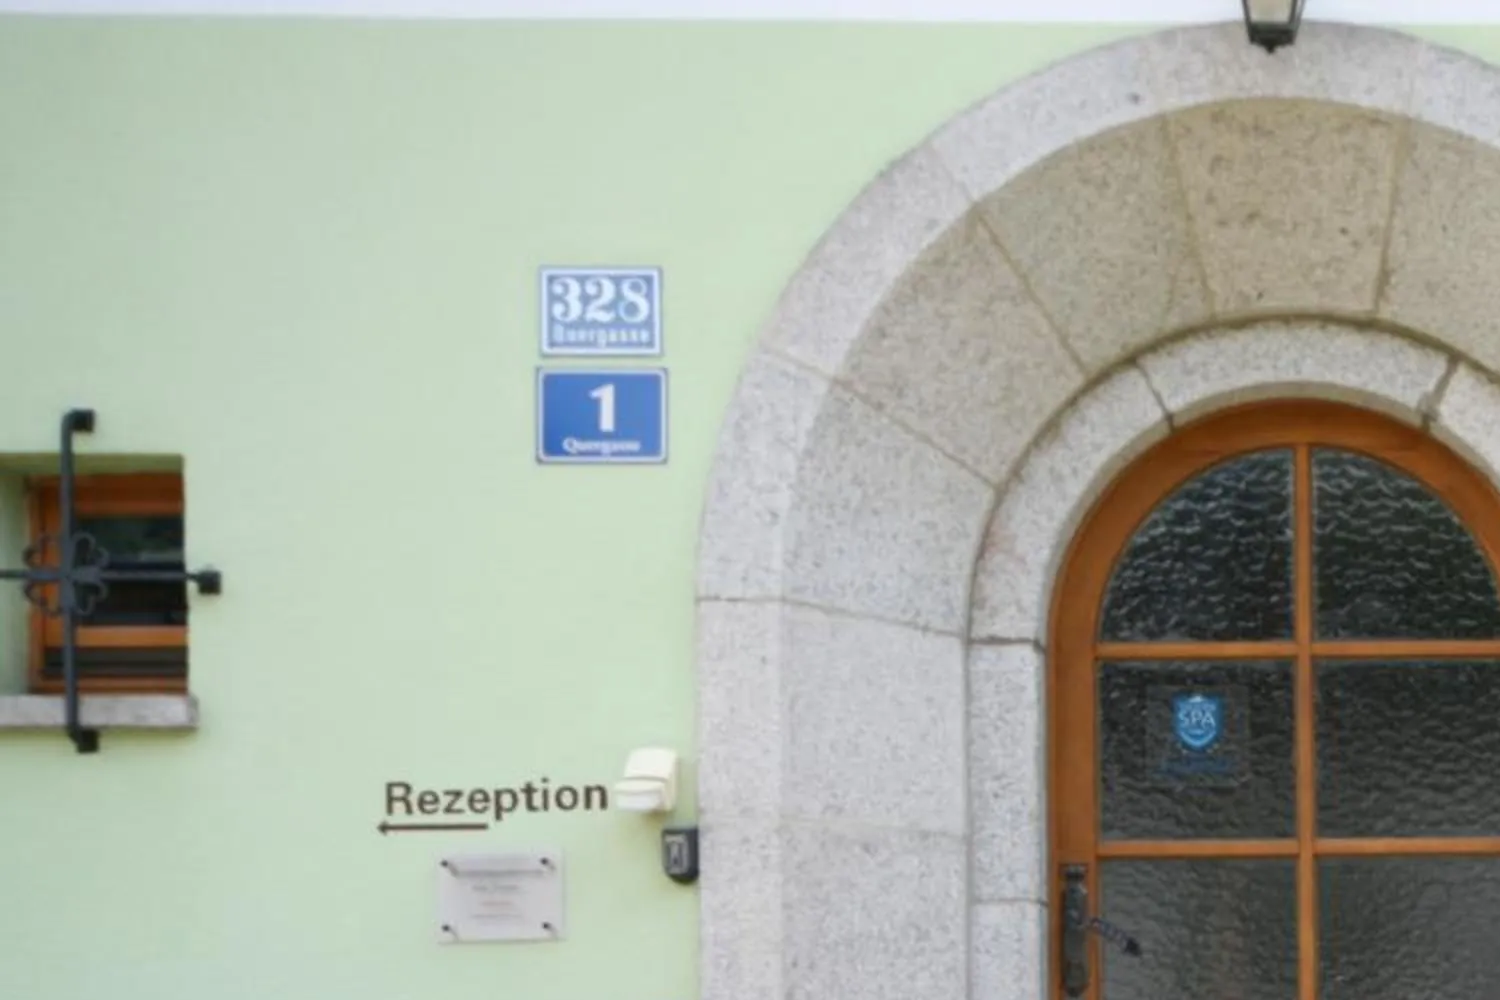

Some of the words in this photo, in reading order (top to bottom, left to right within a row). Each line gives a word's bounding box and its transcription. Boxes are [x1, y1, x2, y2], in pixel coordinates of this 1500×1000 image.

[551, 276, 650, 323] 328
[588, 383, 616, 432] 1
[1177, 709, 1216, 729] SPA
[385, 776, 609, 822] Rezeption
